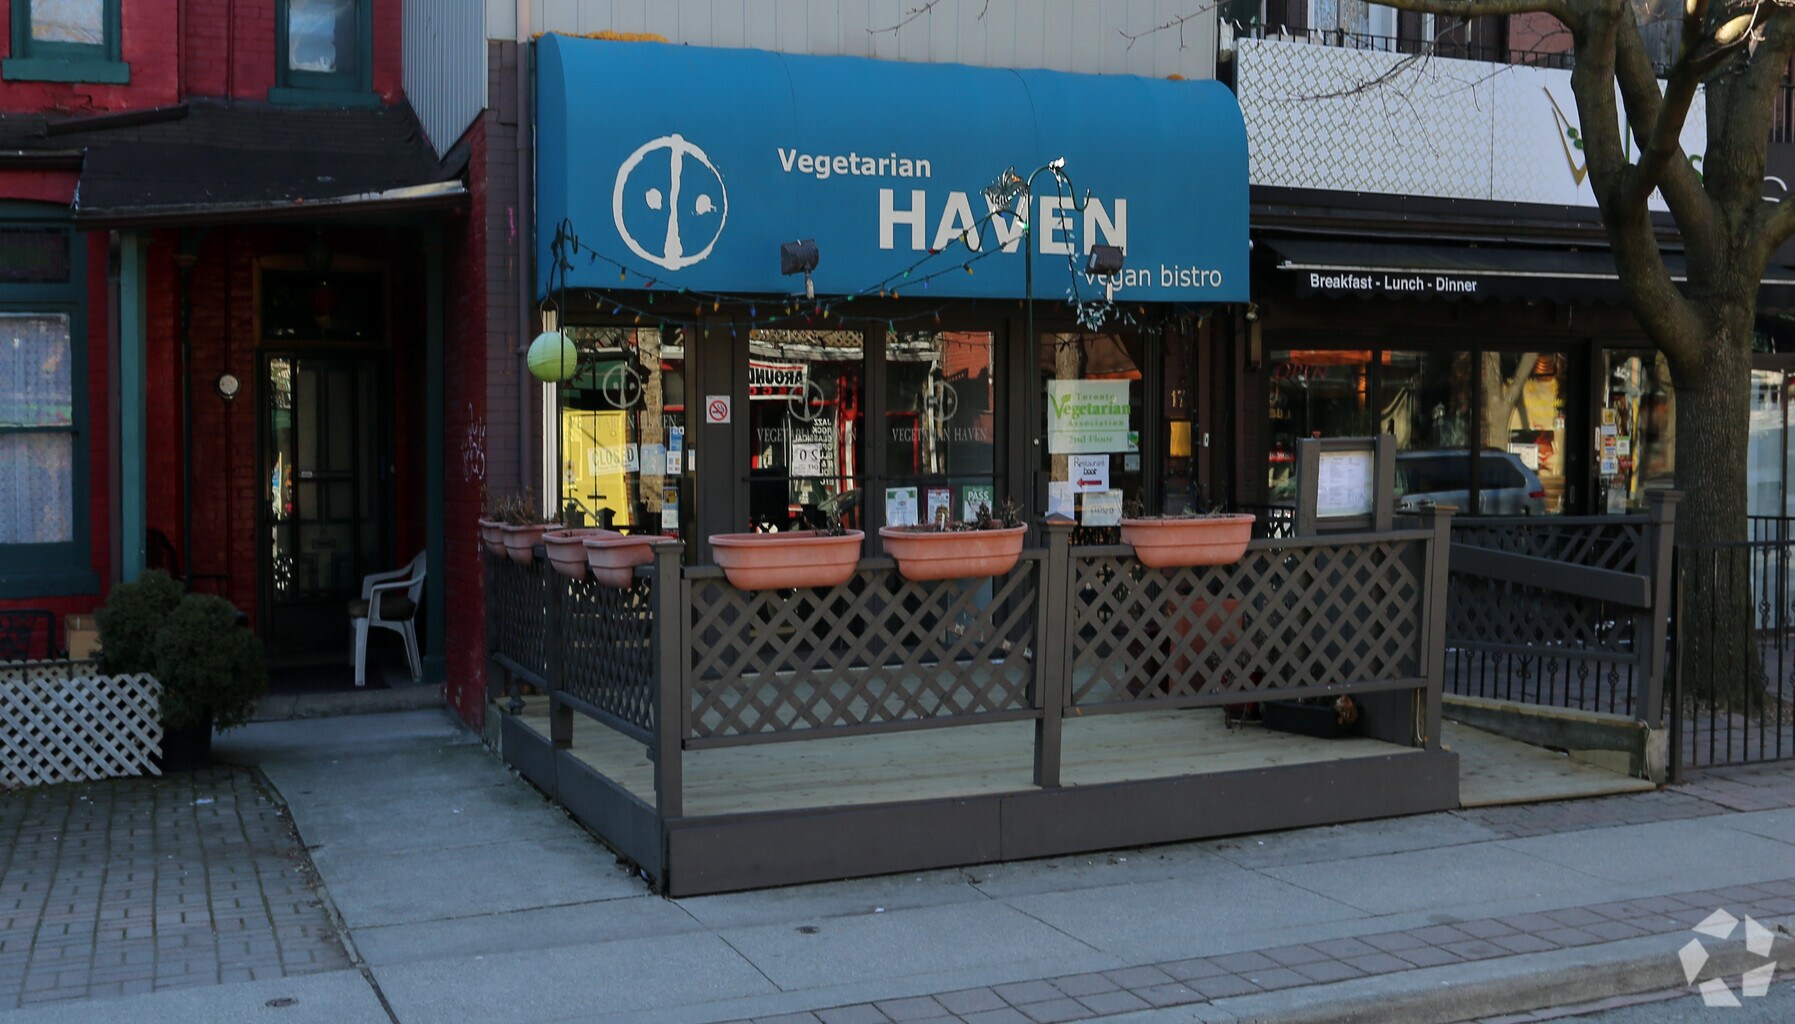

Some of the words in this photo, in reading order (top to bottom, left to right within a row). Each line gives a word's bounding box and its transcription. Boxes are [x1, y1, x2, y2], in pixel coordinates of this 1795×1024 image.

[777, 148, 931, 178] Vegetarian
[878, 188, 1128, 257] HAVEN
[1160, 263, 1222, 287] bistro
[1310, 273, 1373, 290] Breakfast
[1384, 276, 1424, 291] Lunch
[1436, 277, 1477, 292] Dinner
[1050, 394, 1131, 420] Vegetarian
[954, 427, 987, 442] HAVEN
[1069, 435, 1086, 444] 2nd
[1089, 435, 1113, 444] Floor
[967, 490, 990, 502] PASS
